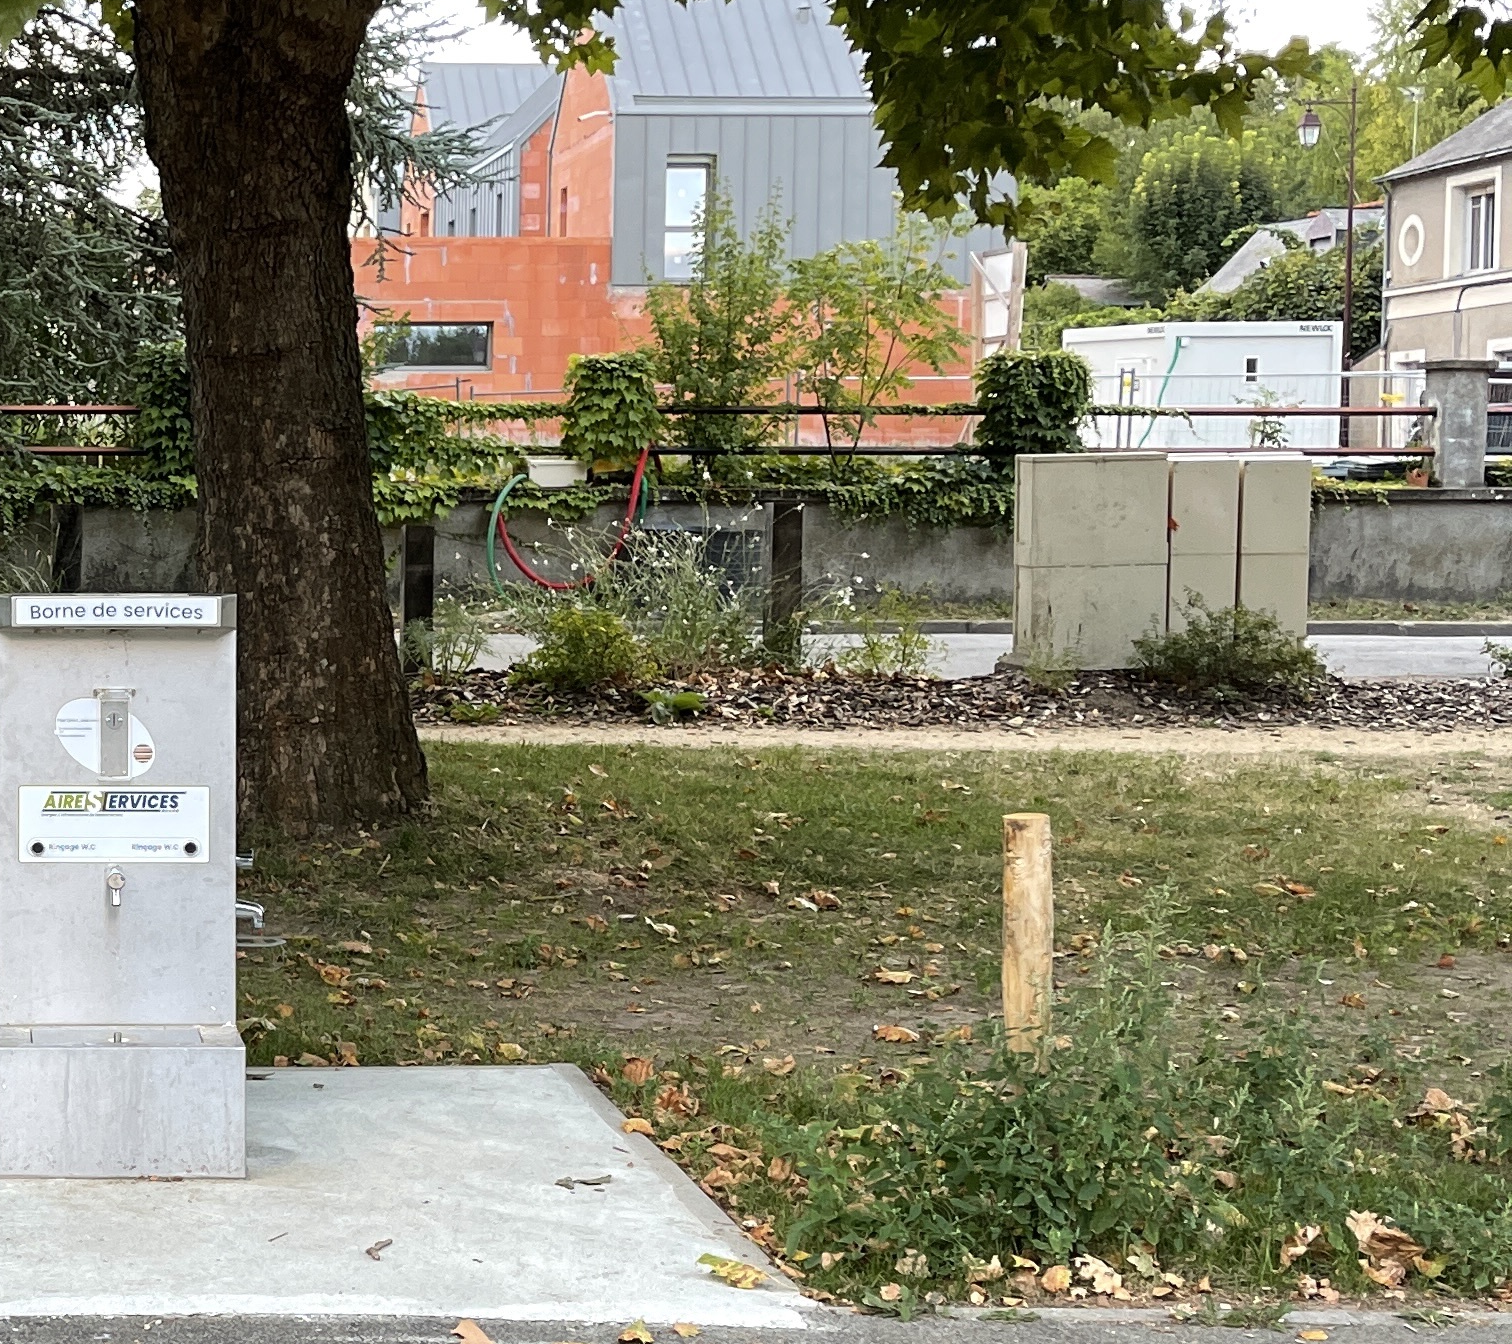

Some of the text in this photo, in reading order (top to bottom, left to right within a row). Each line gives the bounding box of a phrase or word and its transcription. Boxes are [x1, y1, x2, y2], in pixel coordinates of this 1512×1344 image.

[30, 602, 204, 620] Borne de services
